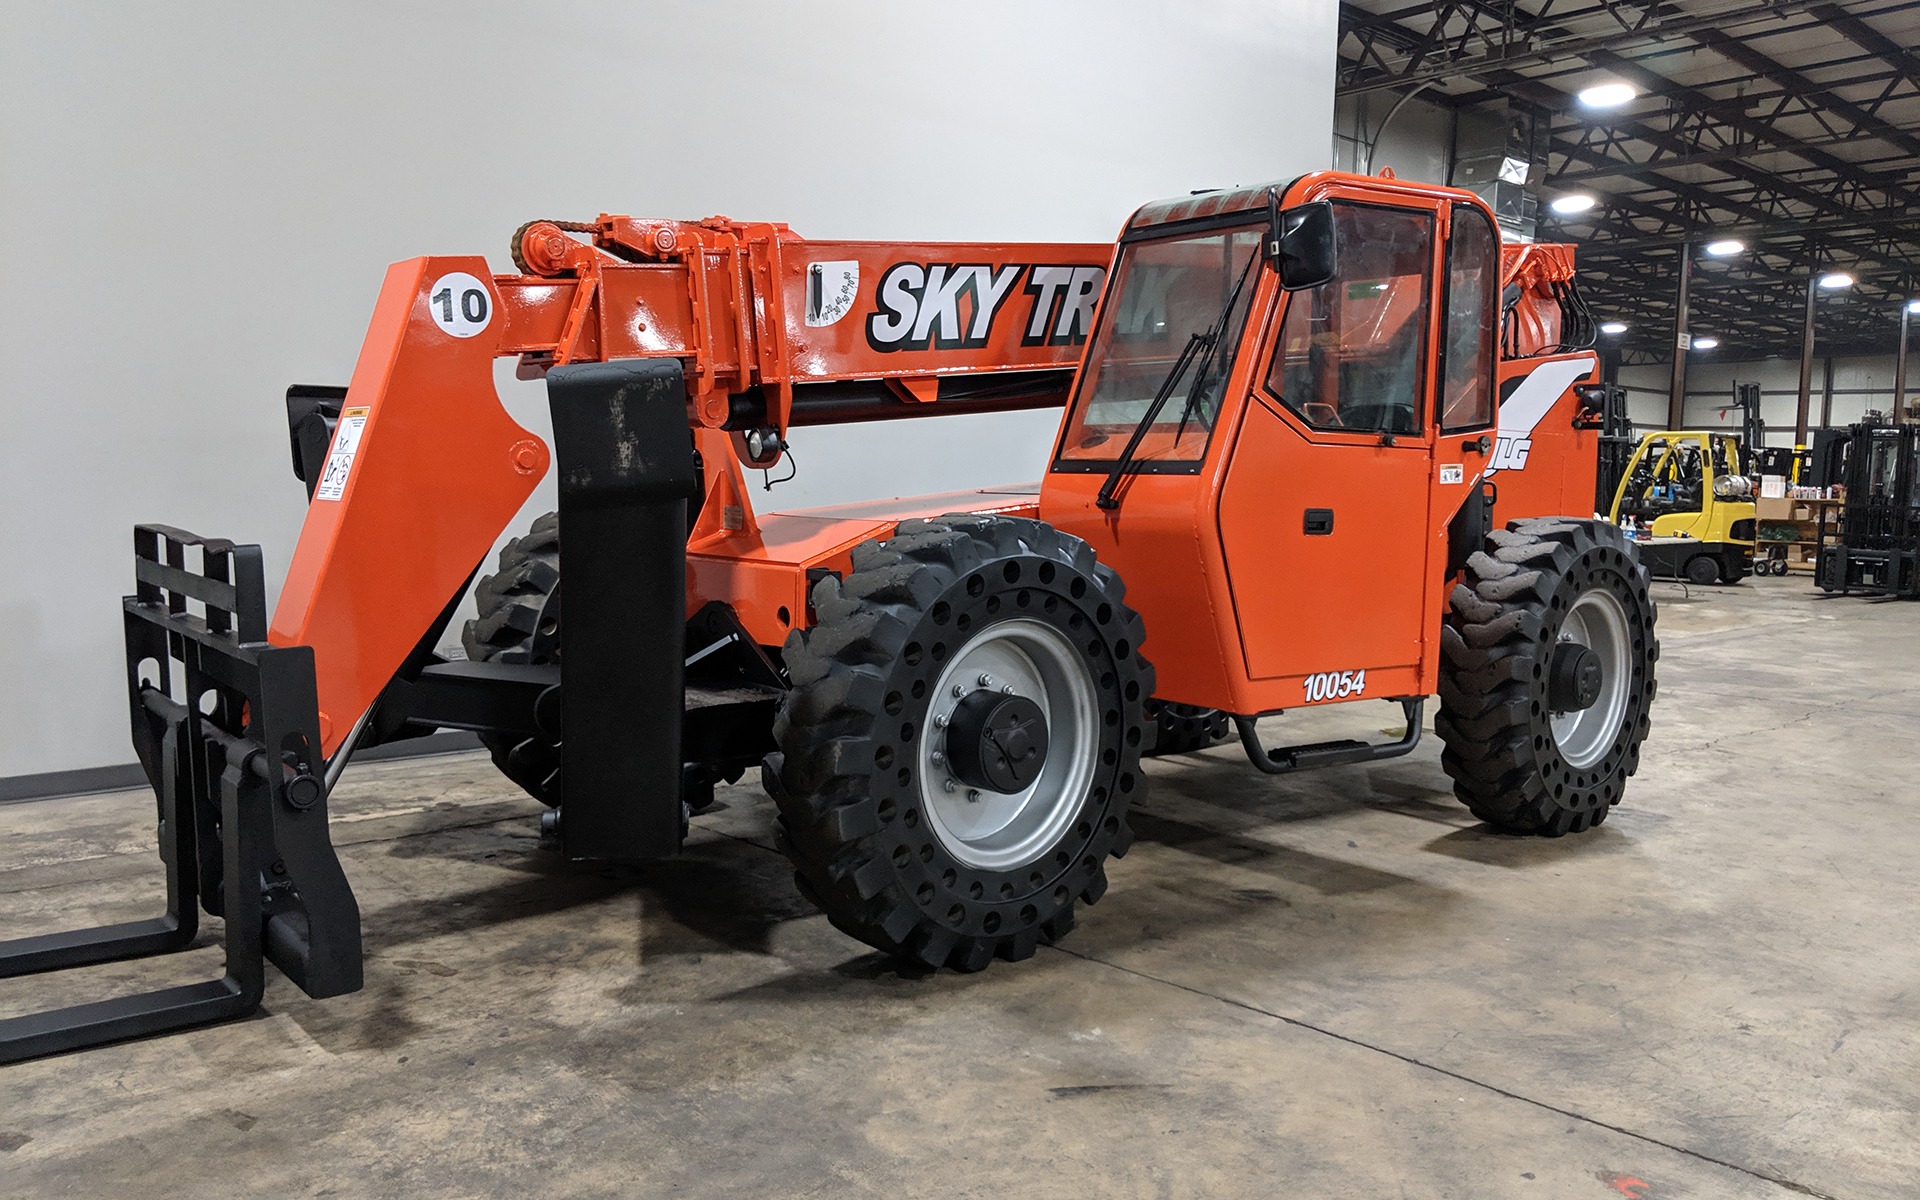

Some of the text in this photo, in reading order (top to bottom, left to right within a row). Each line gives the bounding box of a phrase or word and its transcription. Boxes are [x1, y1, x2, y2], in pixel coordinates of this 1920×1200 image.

[432, 287, 488, 323] 10
[821, 312, 828, 321] 10
[825, 304, 833, 313] 20
[834, 296, 842, 305] 40
[841, 285, 849, 294] 60
[868, 263, 1022, 352] SKY
[1303, 669, 1366, 702] 10054
